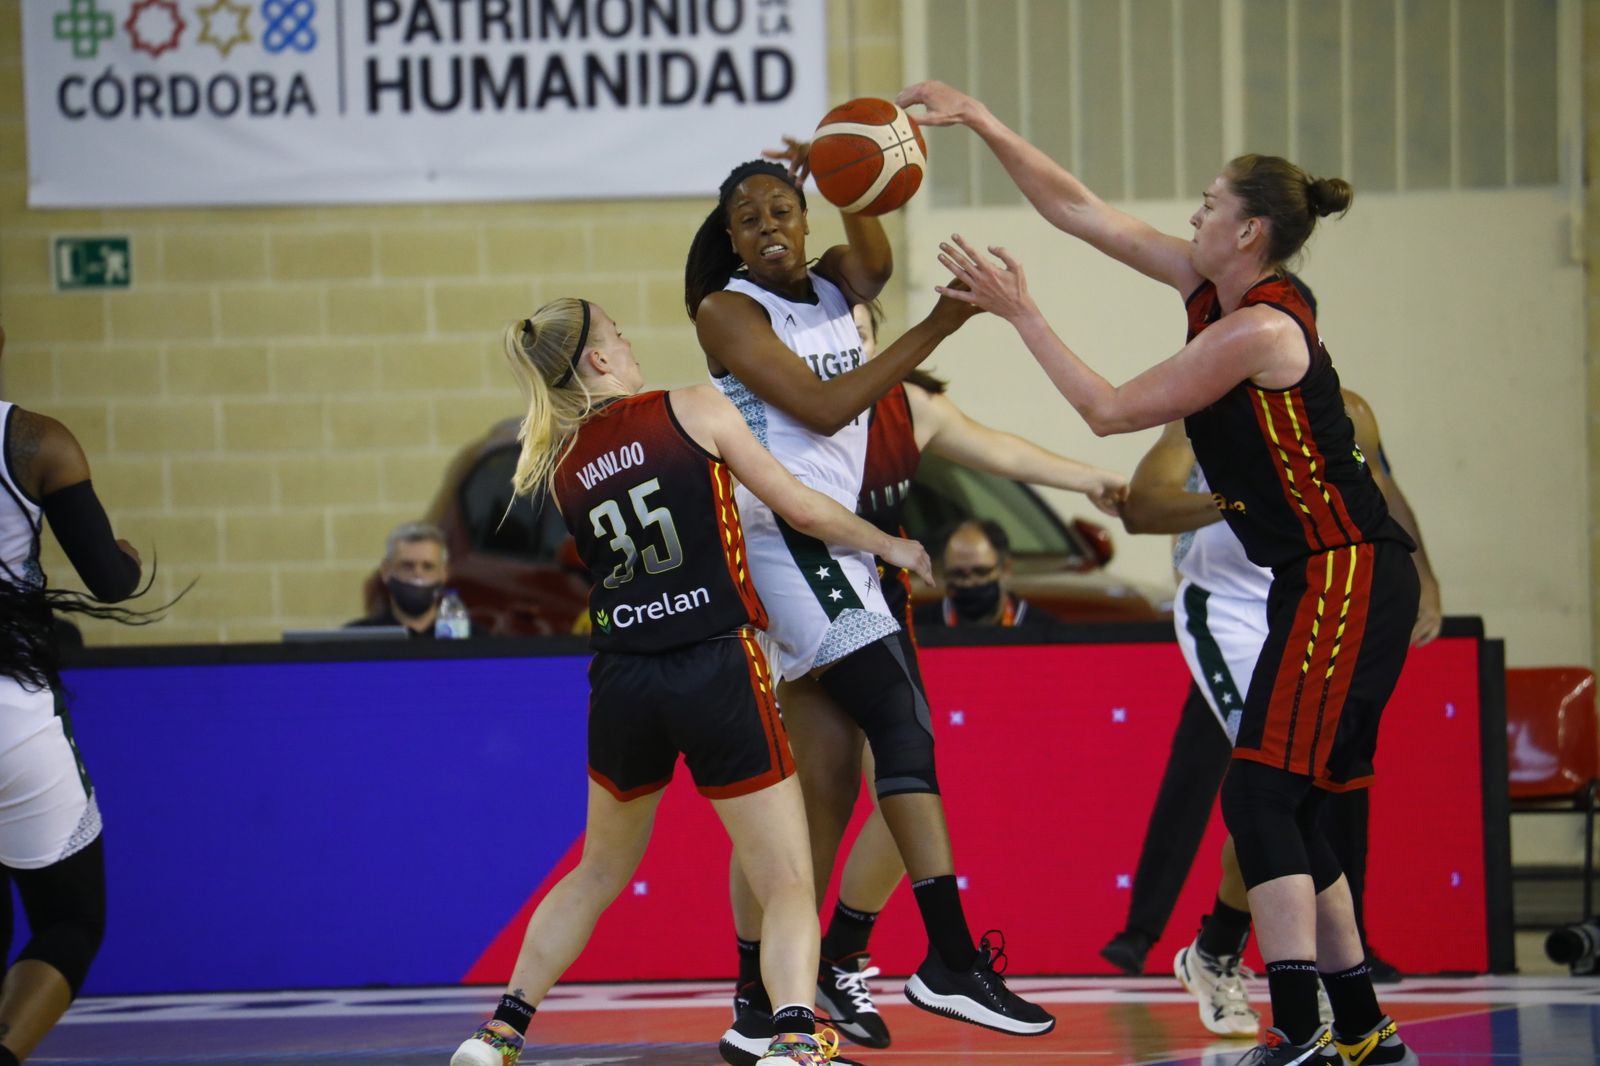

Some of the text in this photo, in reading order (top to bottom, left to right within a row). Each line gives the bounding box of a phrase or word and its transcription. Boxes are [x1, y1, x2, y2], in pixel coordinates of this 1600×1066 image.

[365, 0, 745, 45] PATRIMONIO
[757, 13, 792, 34] LA
[57, 66, 316, 121] CÓRDOBA
[365, 48, 794, 114] HUMANIDAD
[576, 441, 645, 490] VANLOO
[589, 477, 683, 589] 35
[613, 587, 710, 628] Crelan
